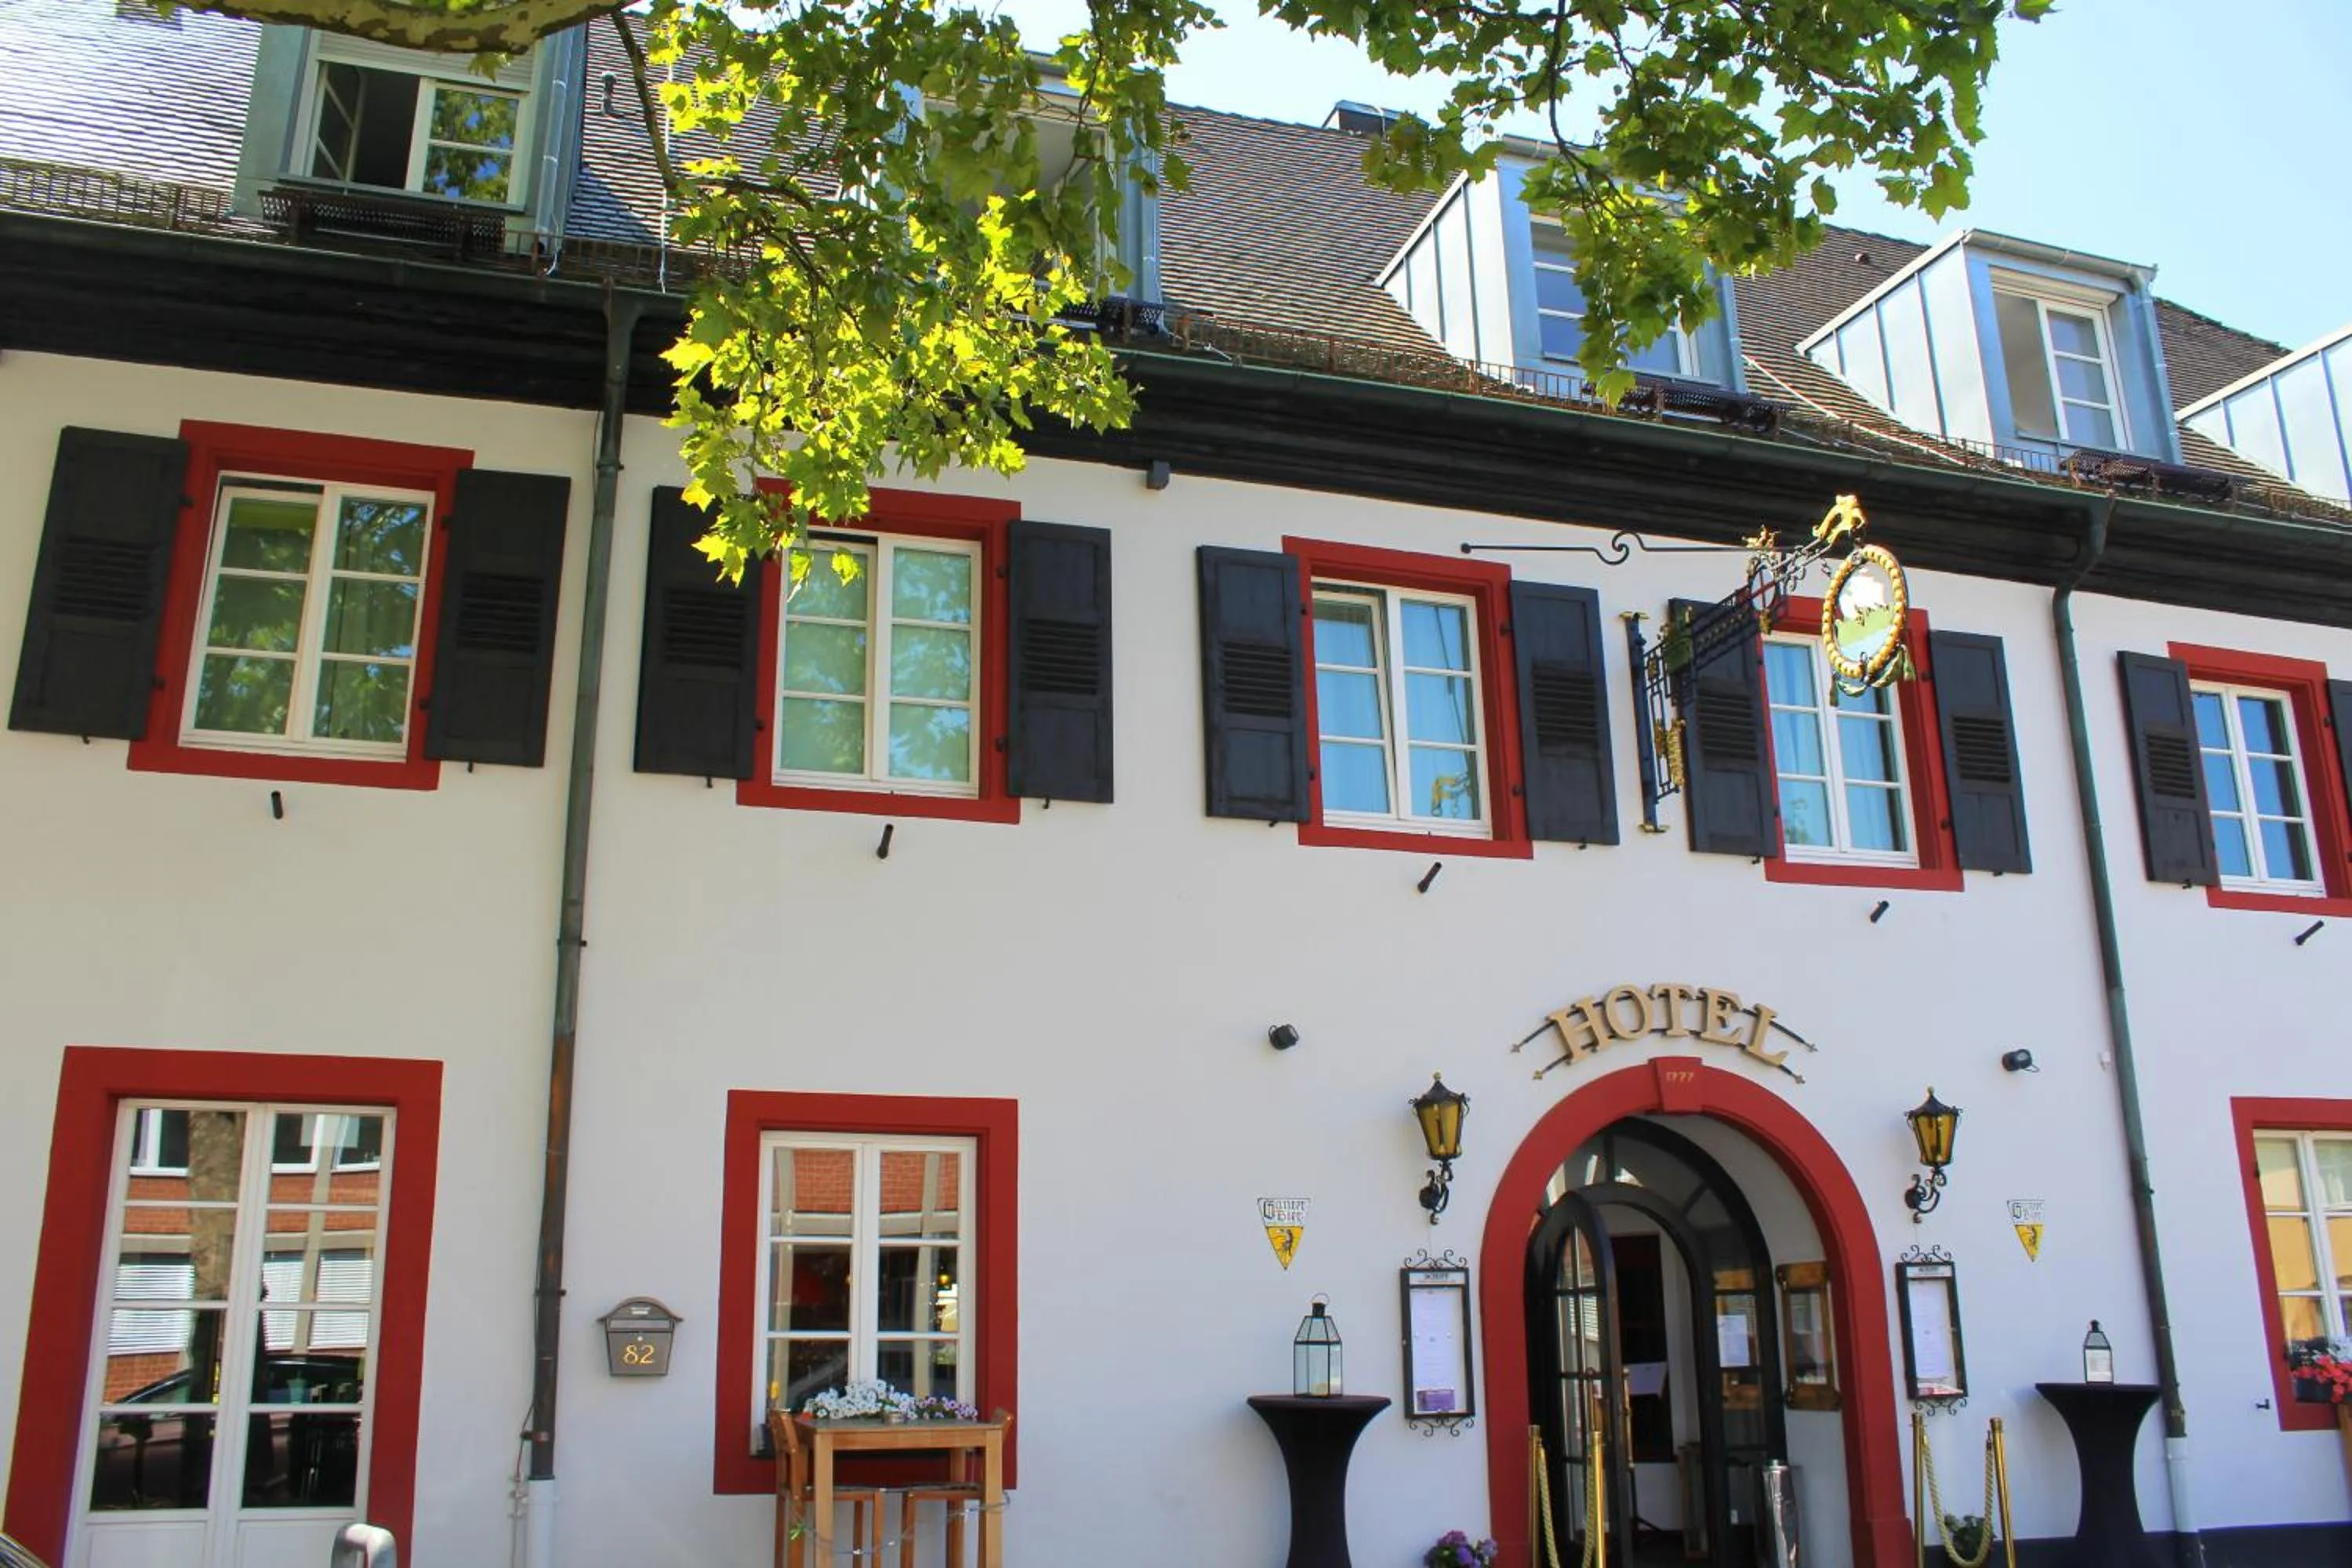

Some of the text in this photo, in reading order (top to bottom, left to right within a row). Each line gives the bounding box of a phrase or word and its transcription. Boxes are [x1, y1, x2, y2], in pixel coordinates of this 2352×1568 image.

[1546, 983, 1788, 1065] HOTEL
[1666, 1071, 1694, 1083] 1777
[623, 1345, 655, 1363] 82
